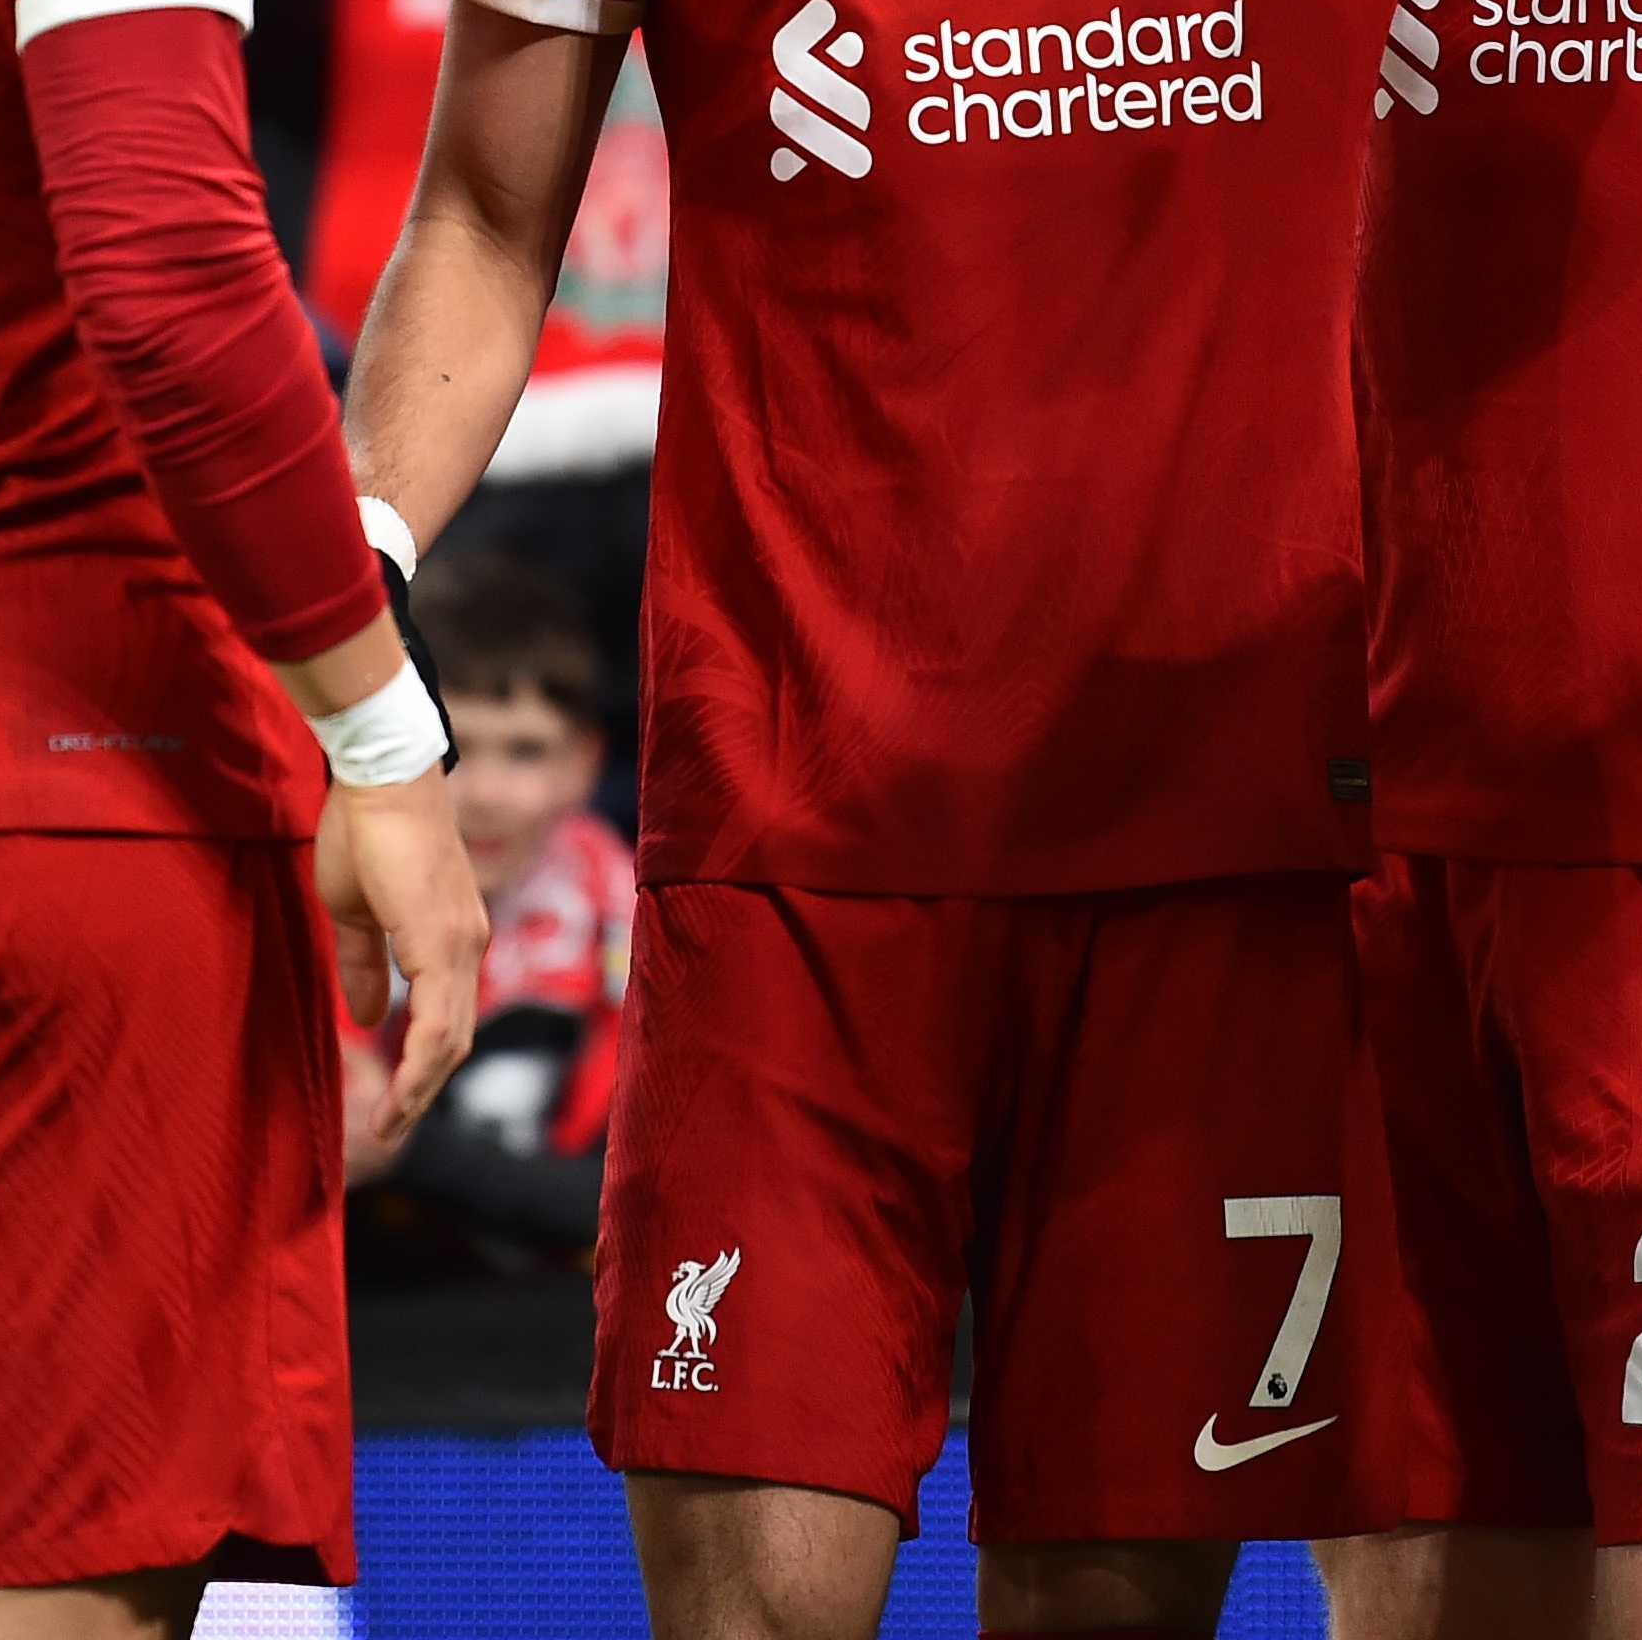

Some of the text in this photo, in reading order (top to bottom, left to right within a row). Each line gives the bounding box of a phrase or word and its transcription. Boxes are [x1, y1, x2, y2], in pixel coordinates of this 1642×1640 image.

[907, 60, 1263, 145] chartered
[1223, 1195, 1342, 1408] 7
[651, 1359, 719, 1392] L.F.C.
